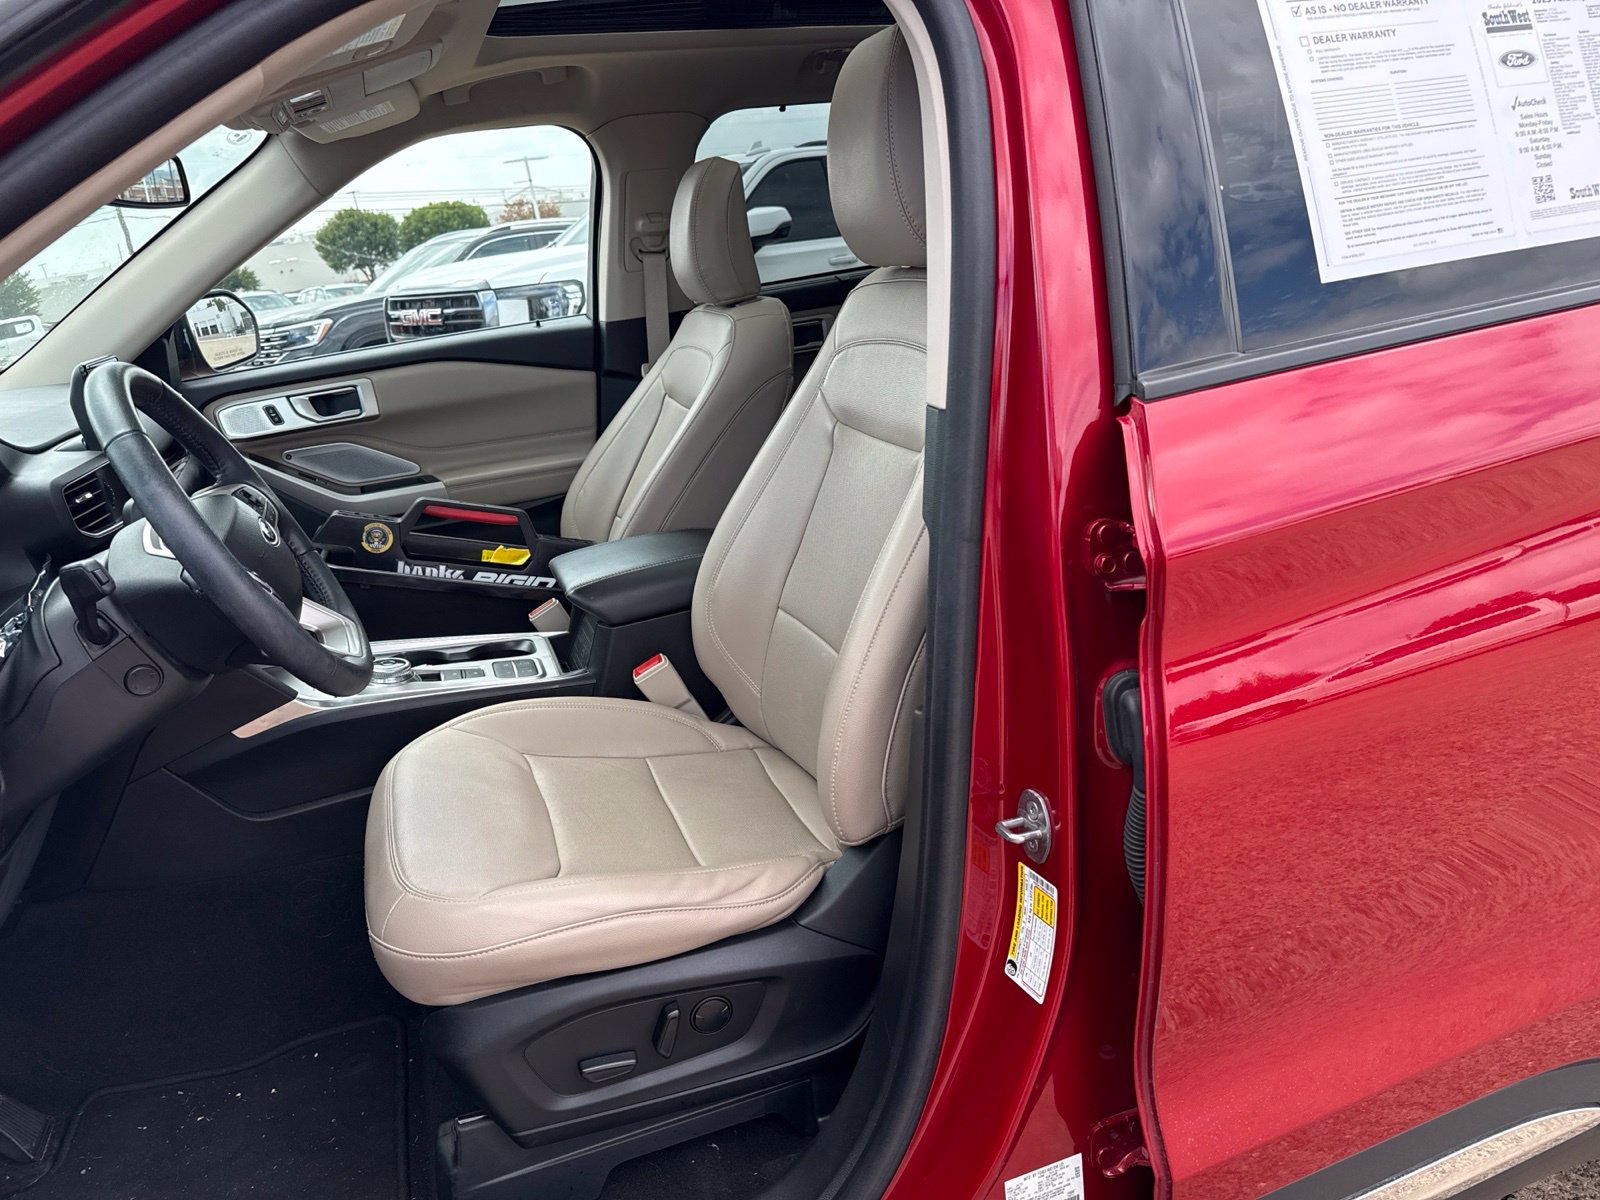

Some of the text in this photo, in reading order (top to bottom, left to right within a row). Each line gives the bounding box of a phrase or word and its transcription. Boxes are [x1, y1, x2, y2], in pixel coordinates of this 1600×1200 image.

[1305, 6, 1317, 15] AS
[1318, 5, 1327, 14] IS
[1333, 3, 1347, 12] NO
[1348, 0, 1382, 11] DEALER
[1313, 28, 1396, 45] DEALER WARRANTY
[1506, 53, 1530, 67] Ford
[400, 307, 443, 326] GMC
